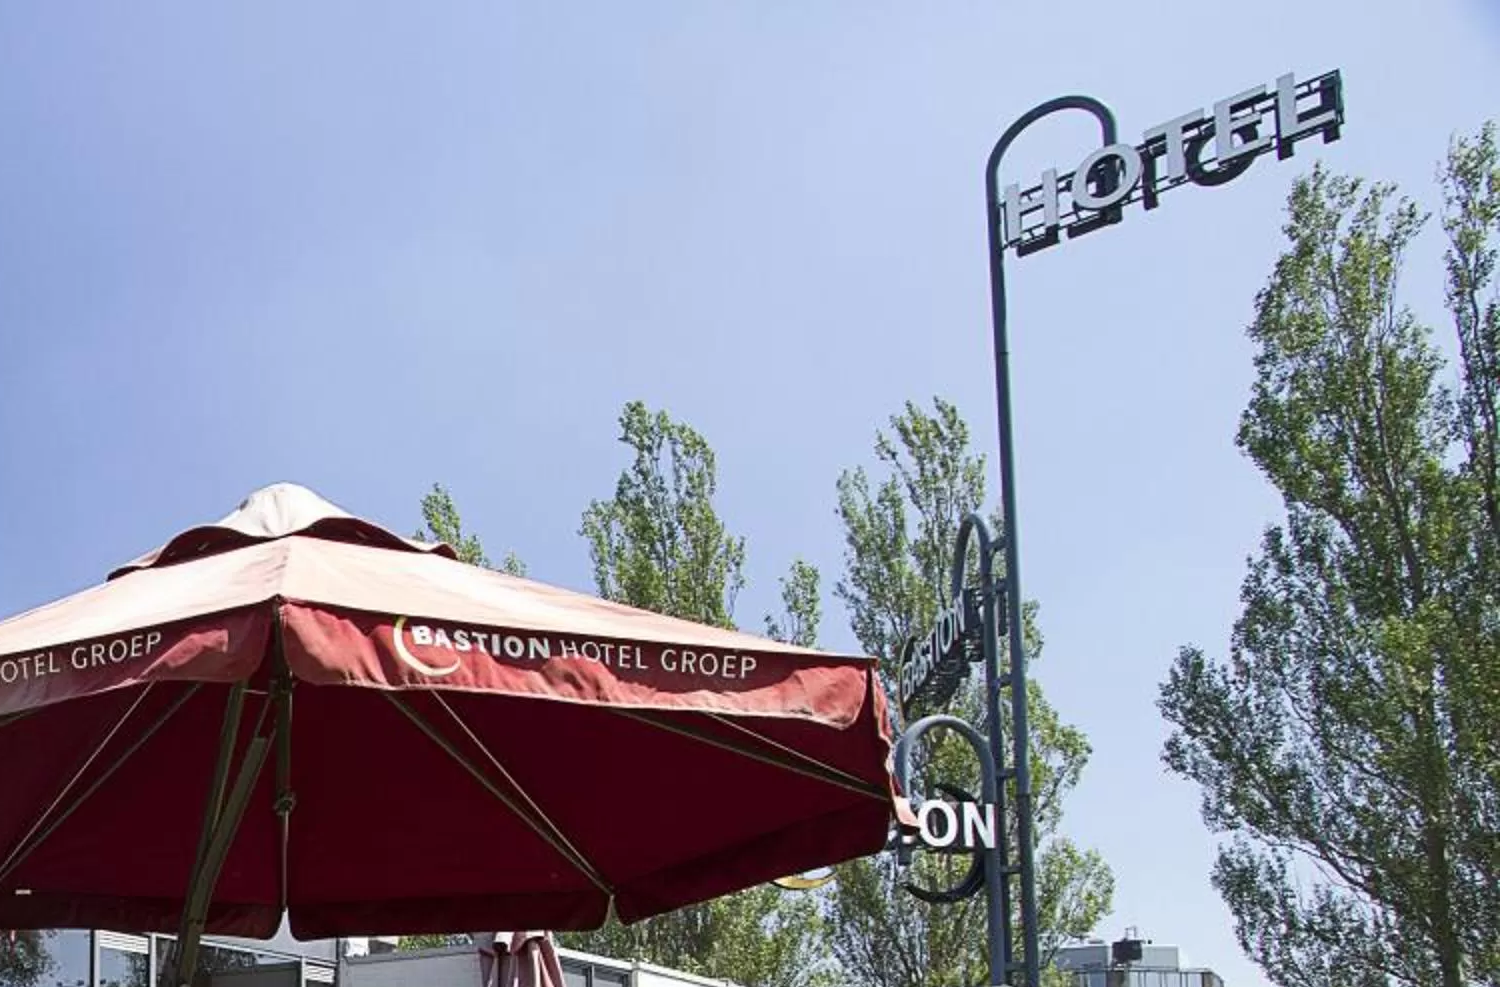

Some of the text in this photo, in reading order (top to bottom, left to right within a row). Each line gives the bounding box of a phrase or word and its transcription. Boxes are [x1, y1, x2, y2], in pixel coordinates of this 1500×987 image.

[1003, 72, 1336, 242] HOTEL
[70, 631, 162, 670] GROEP
[410, 625, 758, 680] BASTION HOTEL GROEP
[888, 799, 997, 849] ON
